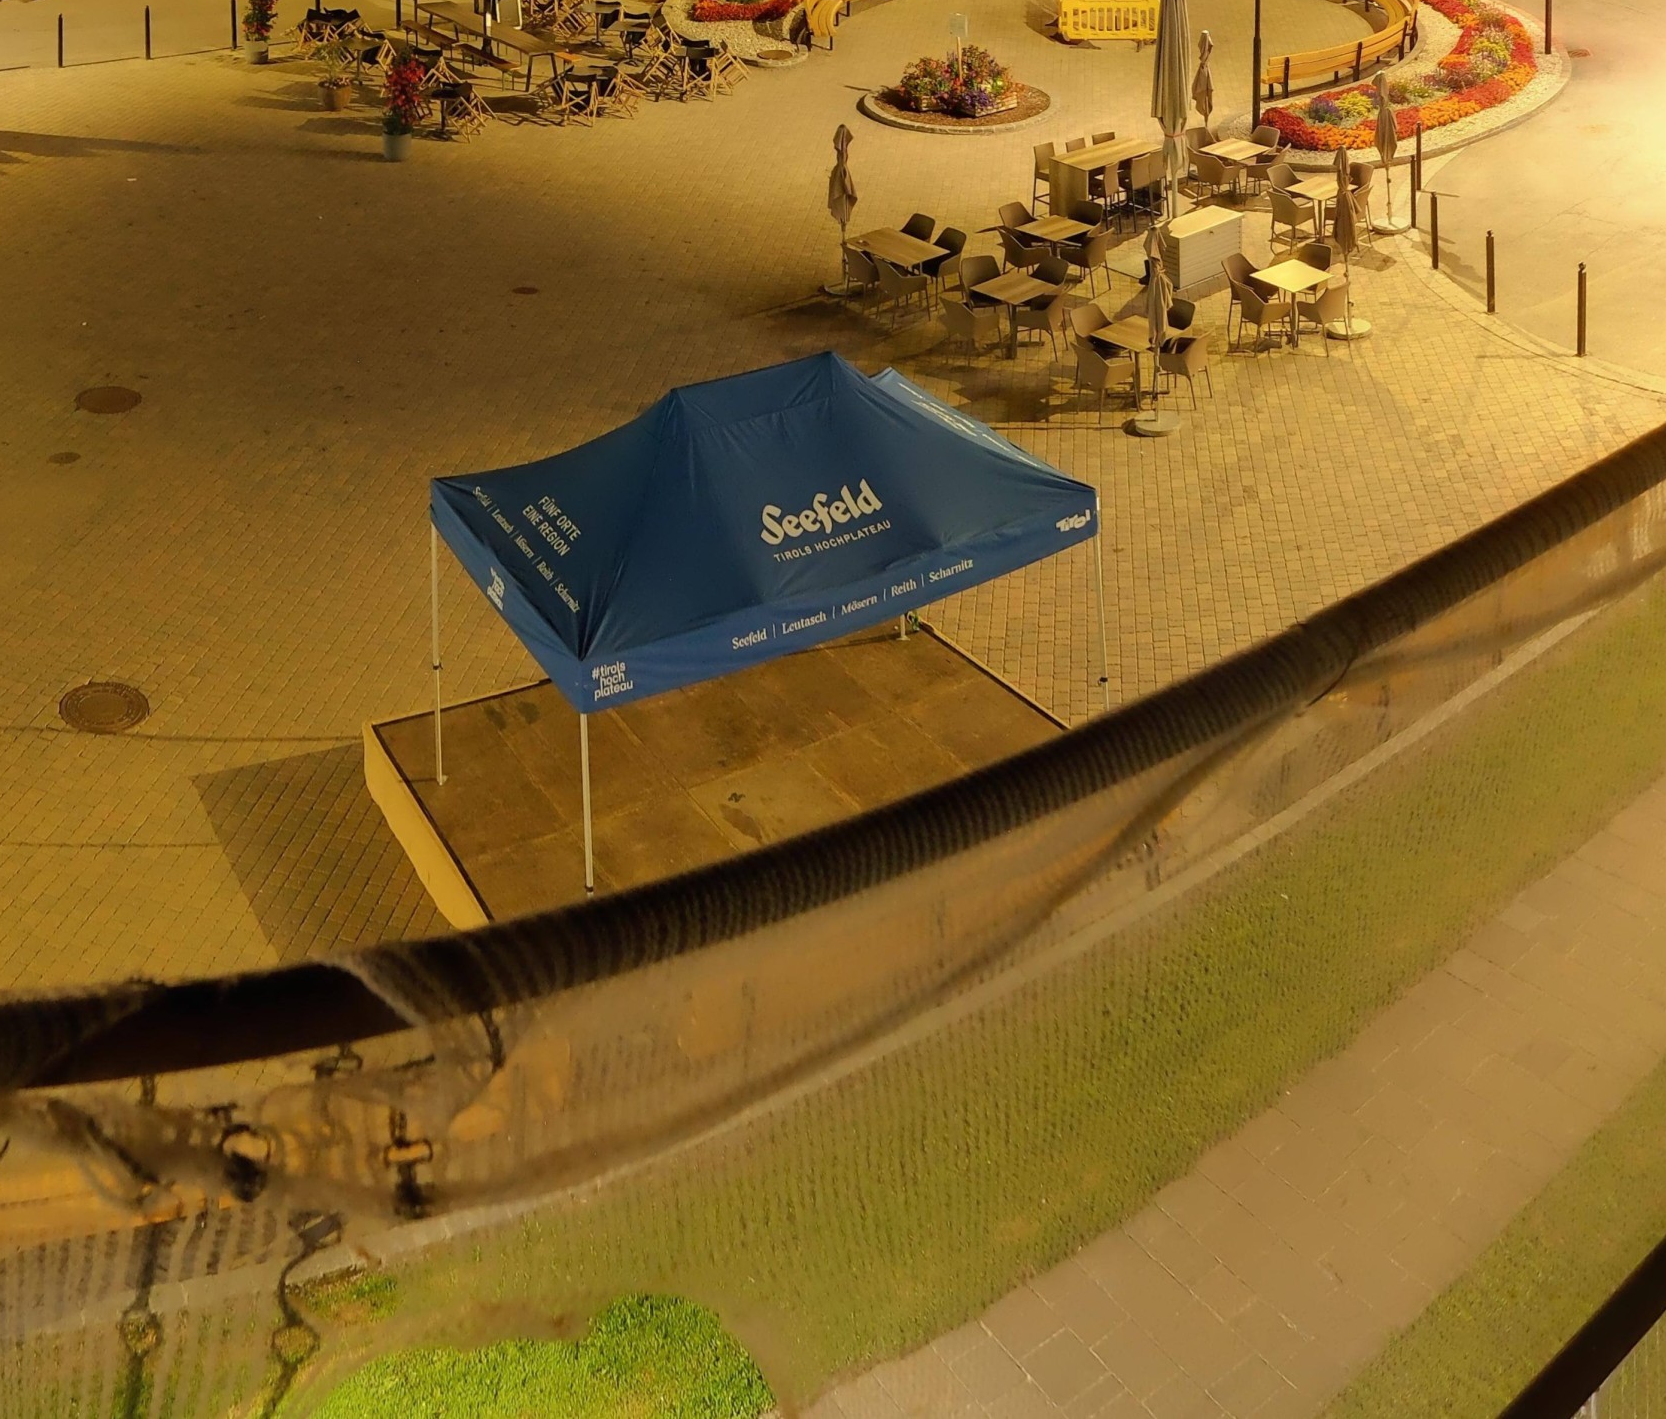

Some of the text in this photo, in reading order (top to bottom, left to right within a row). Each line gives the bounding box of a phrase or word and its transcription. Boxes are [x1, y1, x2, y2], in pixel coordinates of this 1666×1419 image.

[522, 504, 571, 557] EINE REGION
[538, 495, 582, 542] FÜNF ORTE
[760, 478, 883, 546] Seefeld
[774, 519, 891, 563] TIROLS HOCHPLATEAU
[731, 558, 974, 650] Seefeld Leutasch Mösern Reith Scharnitz
[592, 661, 626, 680] #tirols
[594, 680, 633, 701] plateau
[600, 670, 625, 686] hoch
